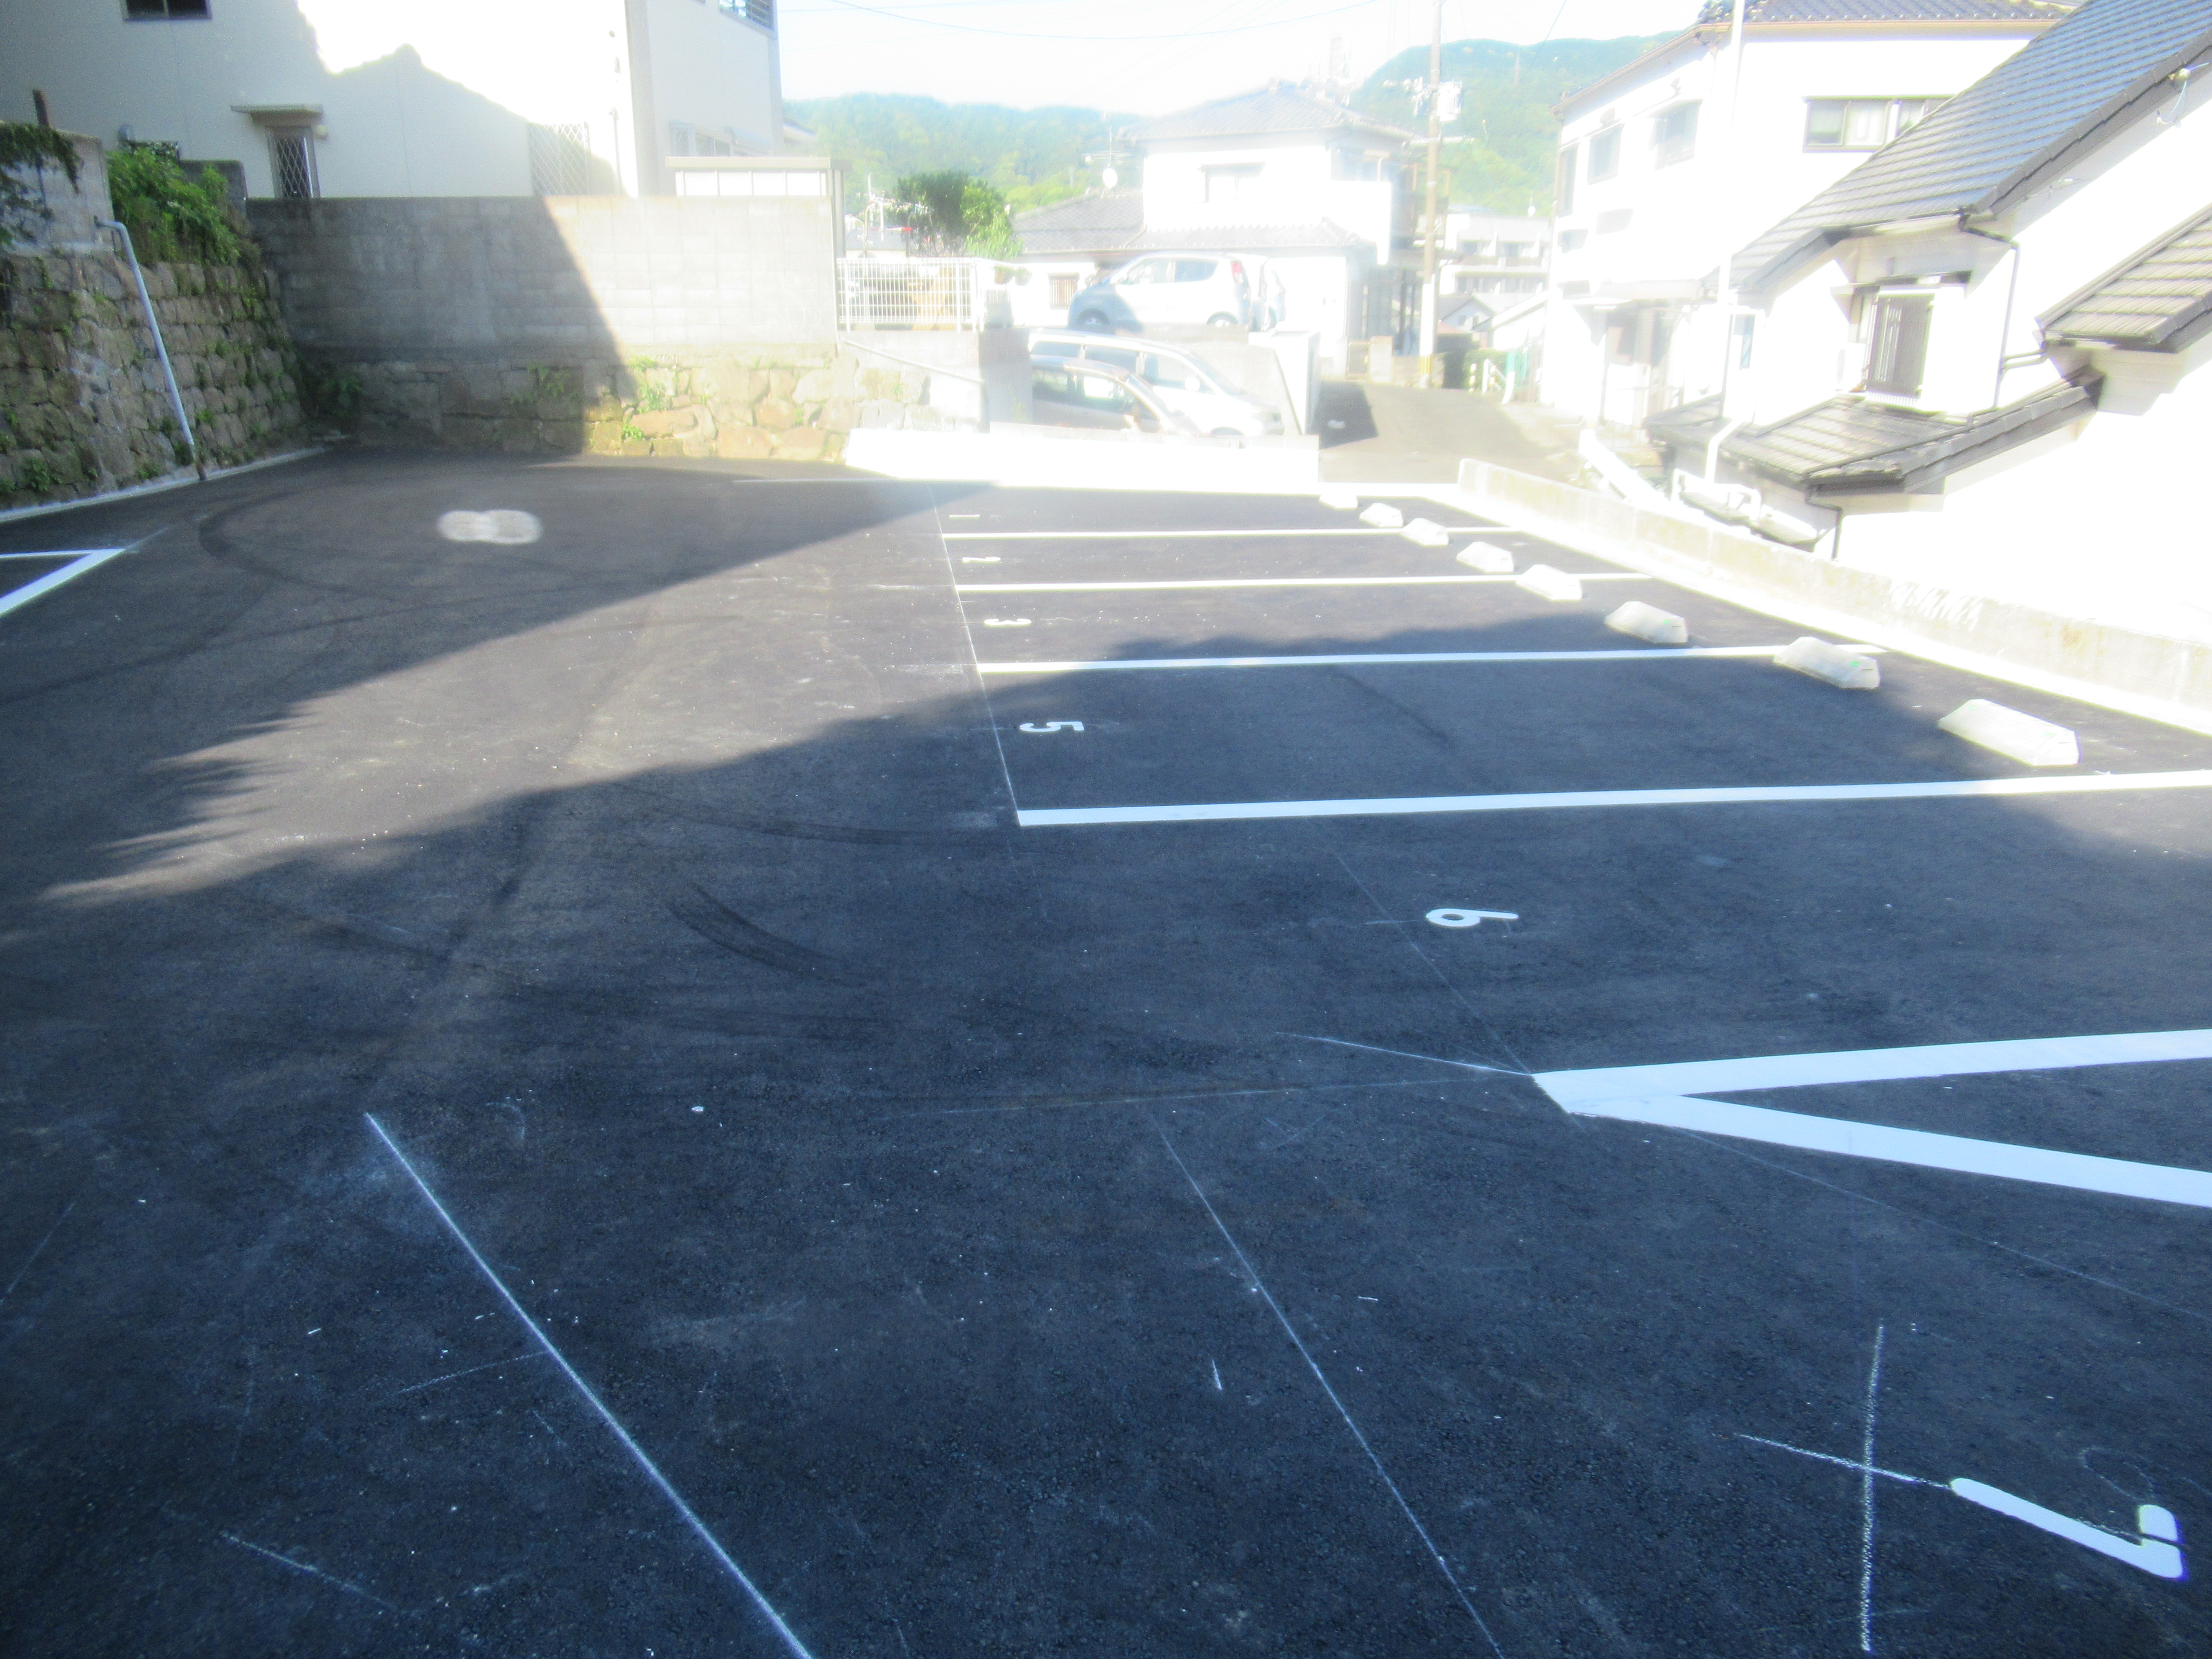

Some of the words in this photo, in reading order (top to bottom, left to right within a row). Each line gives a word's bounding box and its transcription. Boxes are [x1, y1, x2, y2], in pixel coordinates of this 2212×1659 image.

[984, 618, 1032, 626] 3
[1019, 721, 1085, 733] 5
[1425, 908, 1519, 927] 6
[1950, 1478, 2183, 1578] 7
